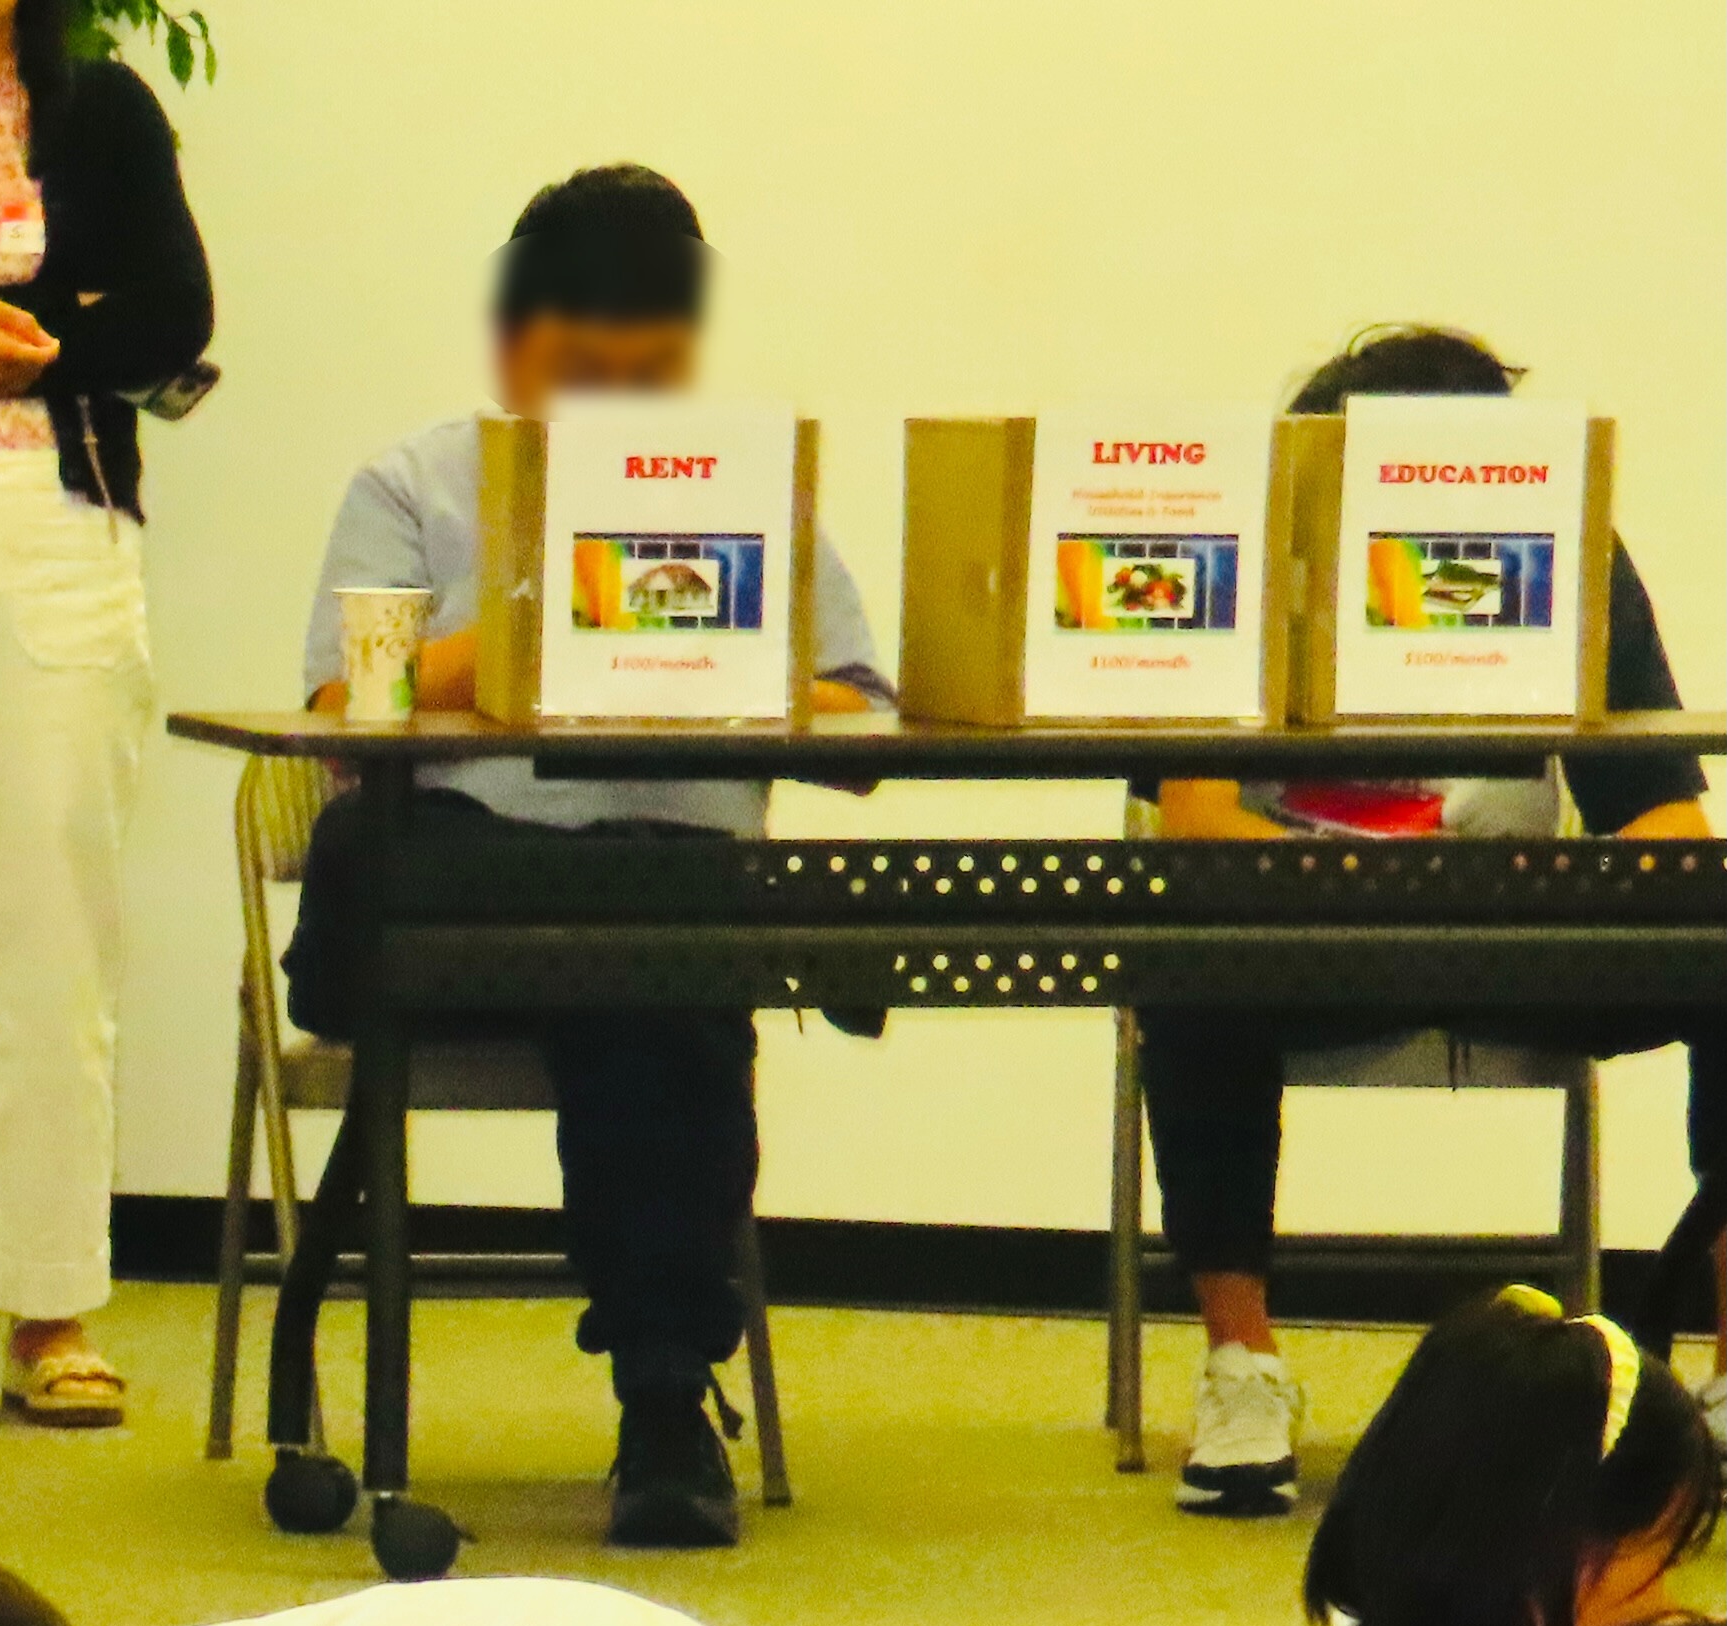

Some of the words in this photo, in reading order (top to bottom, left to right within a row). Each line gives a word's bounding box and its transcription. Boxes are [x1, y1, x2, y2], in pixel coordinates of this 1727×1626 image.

[1092, 442, 1207, 464] LIVING
[625, 457, 717, 479] RENT
[1379, 464, 1549, 484] EDUCATION
